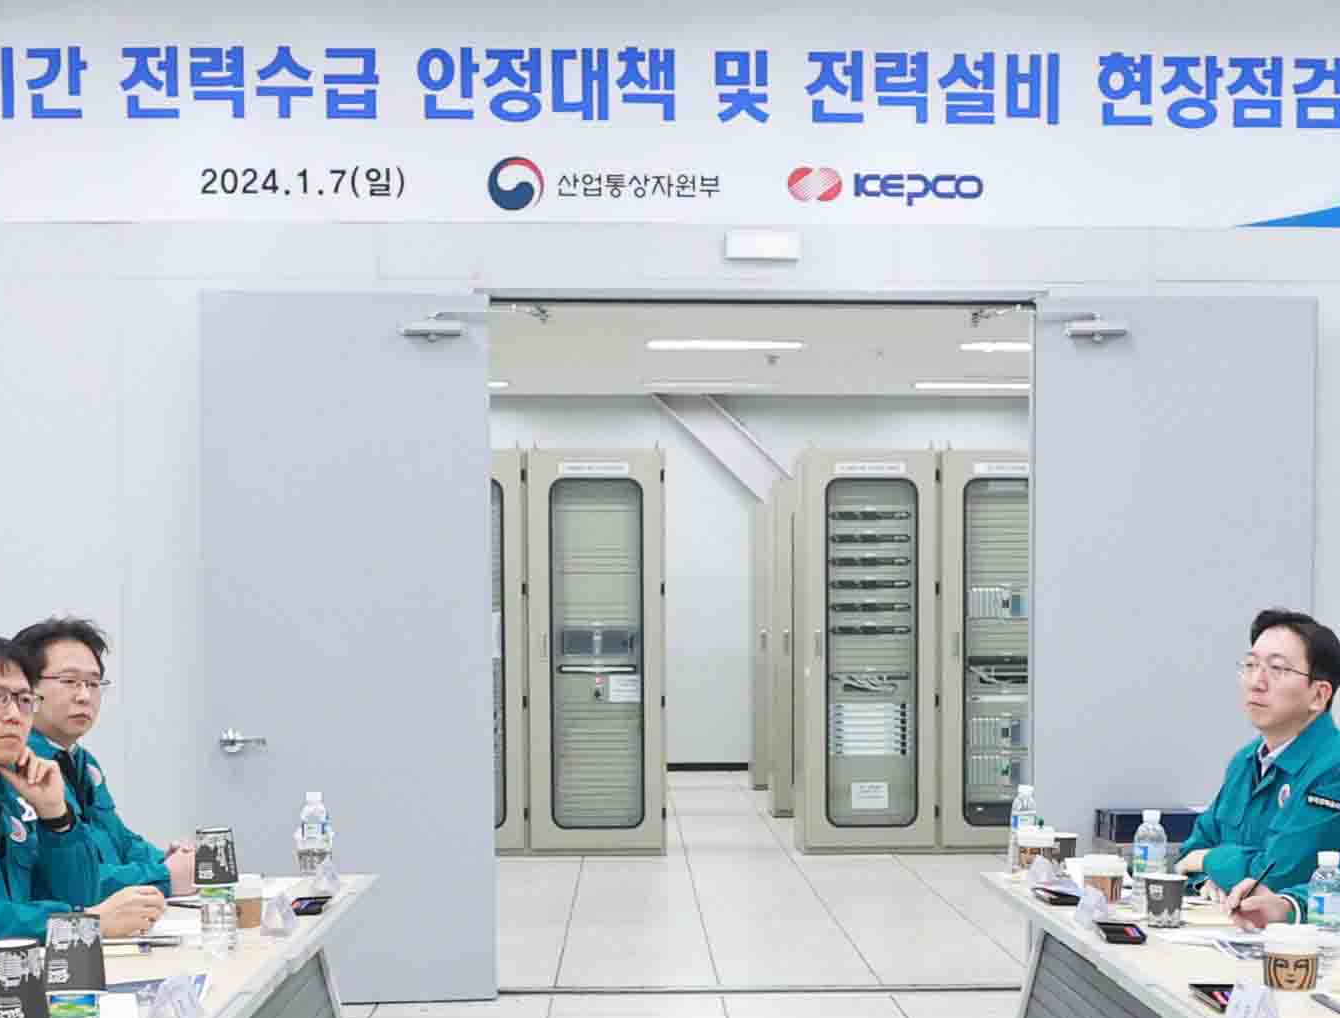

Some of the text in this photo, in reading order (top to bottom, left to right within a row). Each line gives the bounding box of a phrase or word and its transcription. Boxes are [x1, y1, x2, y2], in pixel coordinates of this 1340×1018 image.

[120, 46, 380, 121] 전력수급
[418, 47, 677, 123] 안정대책
[714, 48, 770, 124] 및
[804, 49, 1061, 126] 전력설비
[200, 165, 406, 199] 2024.1.7(일)
[557, 172, 722, 200] 산업통상자원부
